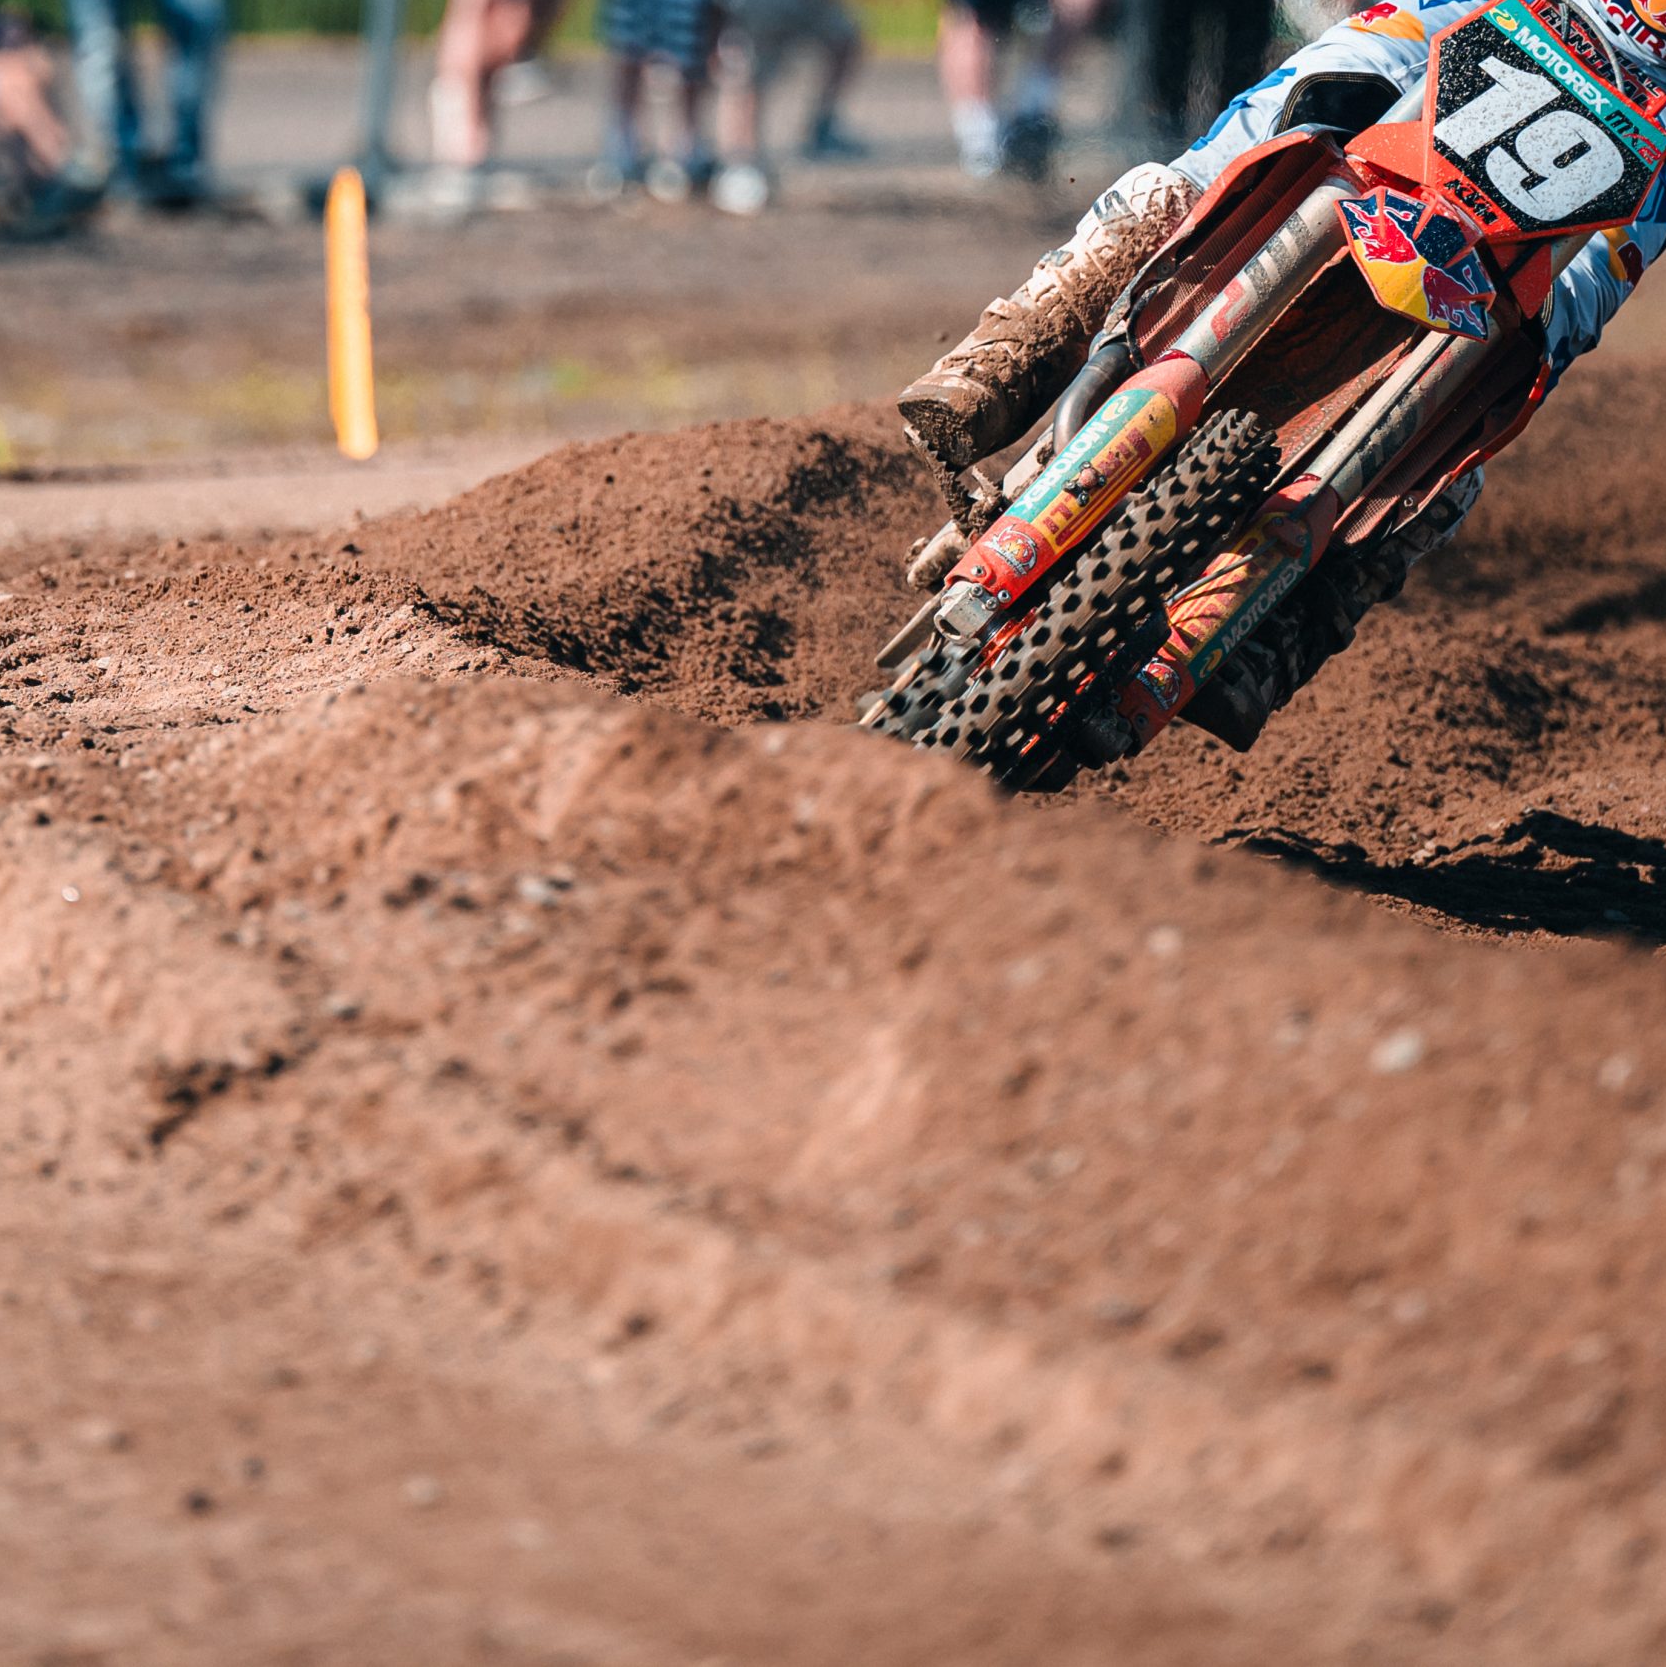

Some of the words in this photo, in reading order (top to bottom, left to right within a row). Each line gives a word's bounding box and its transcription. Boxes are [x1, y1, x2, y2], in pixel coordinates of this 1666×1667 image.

[1515, 25, 1611, 114] MOTOREX
[1433, 55, 1625, 222] 19
[1445, 179, 1498, 225] KTM
[1016, 422, 1110, 511] MOTOREX
[1042, 428, 1153, 546] PIRLI
[1221, 558, 1306, 654] MOTOREX
